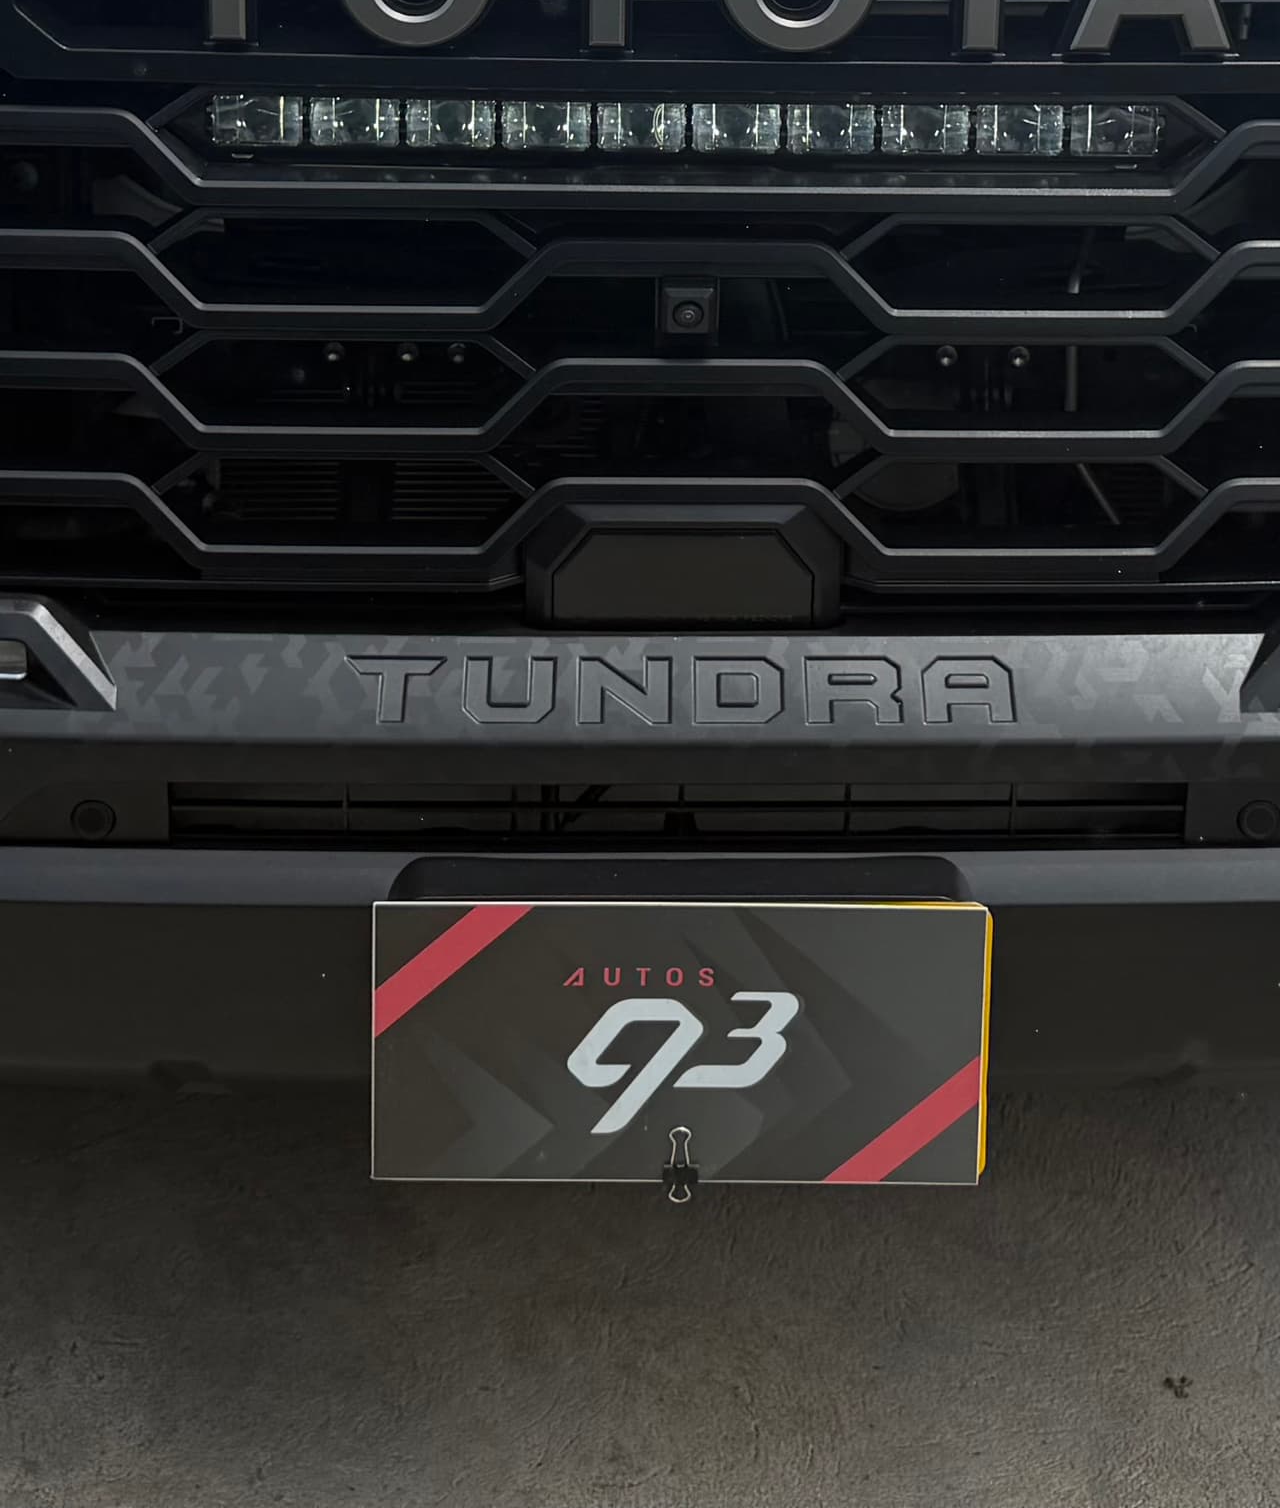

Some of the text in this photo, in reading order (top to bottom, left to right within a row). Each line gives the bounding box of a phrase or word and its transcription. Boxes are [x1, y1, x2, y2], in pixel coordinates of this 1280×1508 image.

[344, 654, 1019, 726] TUNDRA
[563, 967, 715, 987] AUTOS
[567, 991, 800, 1134] 93
